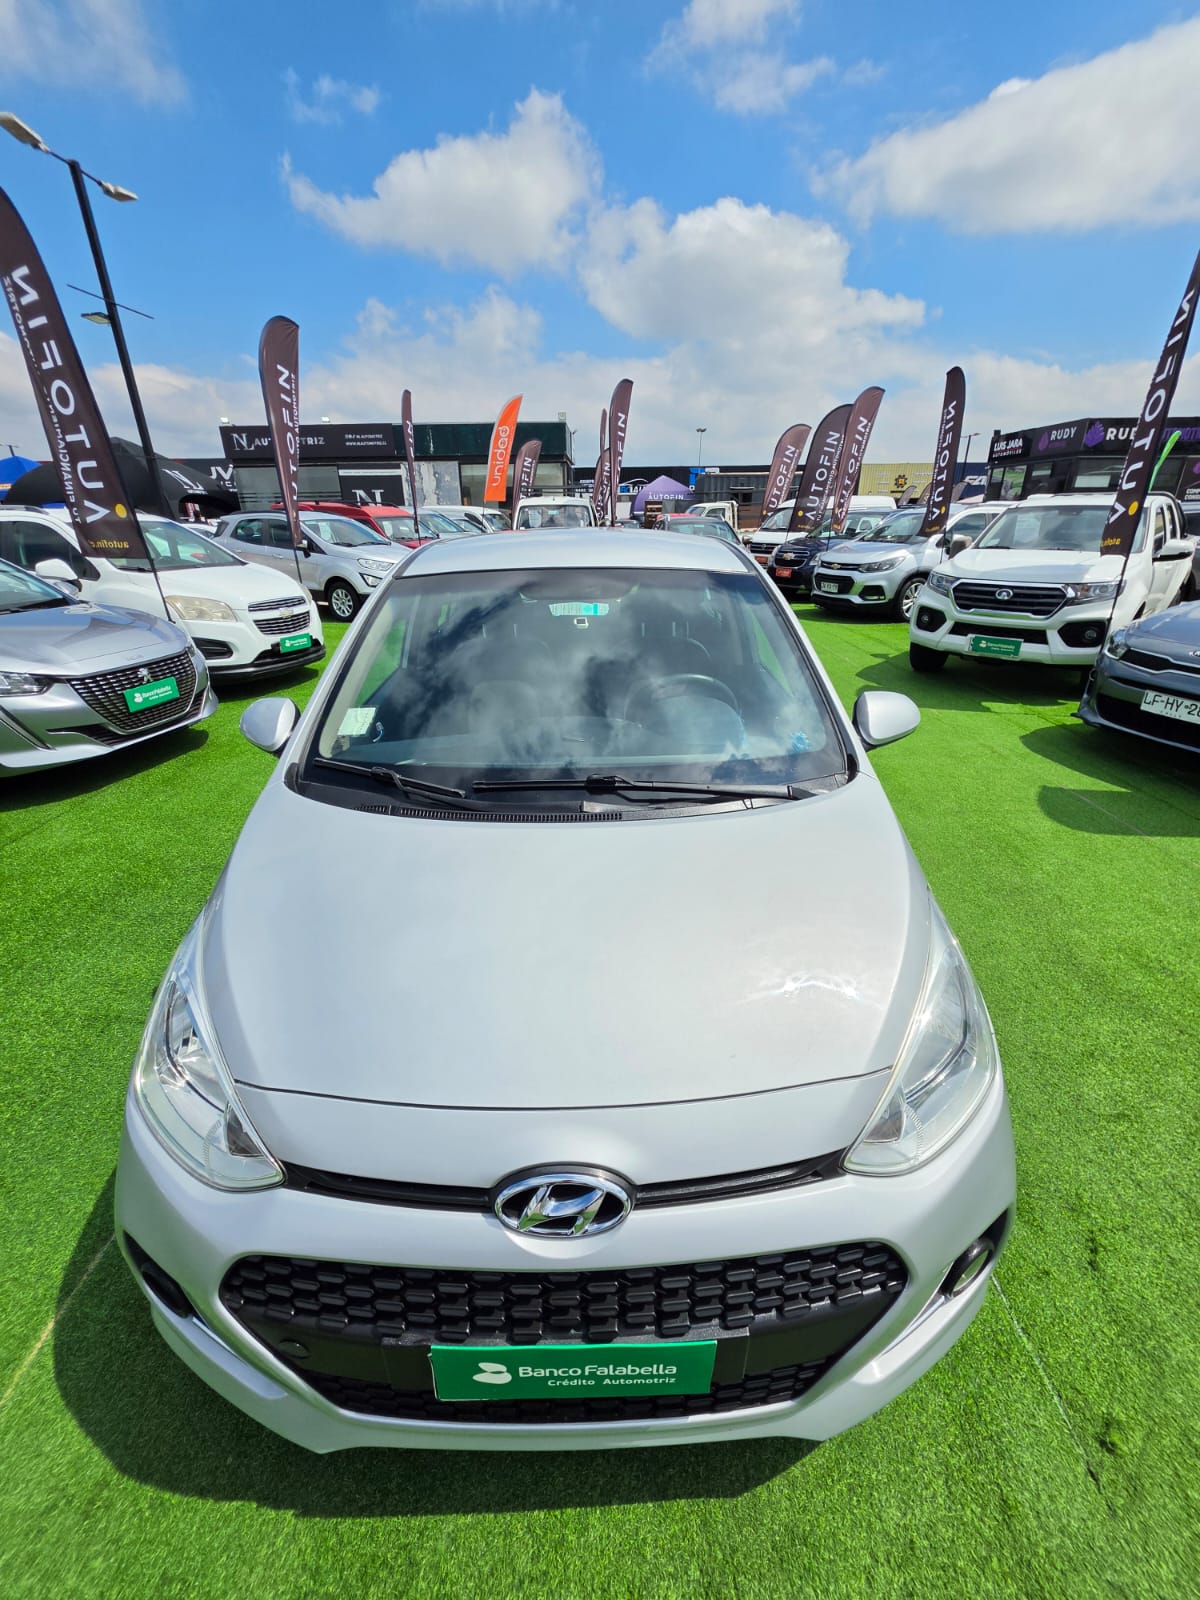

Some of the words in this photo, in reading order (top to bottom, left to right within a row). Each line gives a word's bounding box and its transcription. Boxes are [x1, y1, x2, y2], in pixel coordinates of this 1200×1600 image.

[1051, 426, 1078, 441] RUDY
[1006, 438, 1023, 450] JARA
[491, 425, 510, 487] unidad
[804, 431, 840, 521] AUTOFIN
[648, 492, 684, 500] AUTOFIN
[518, 1366, 582, 1378] Banco
[584, 1364, 677, 1376] Falabella
[547, 1377, 596, 1386] Crédito
[602, 1376, 677, 1385] Automotriz
